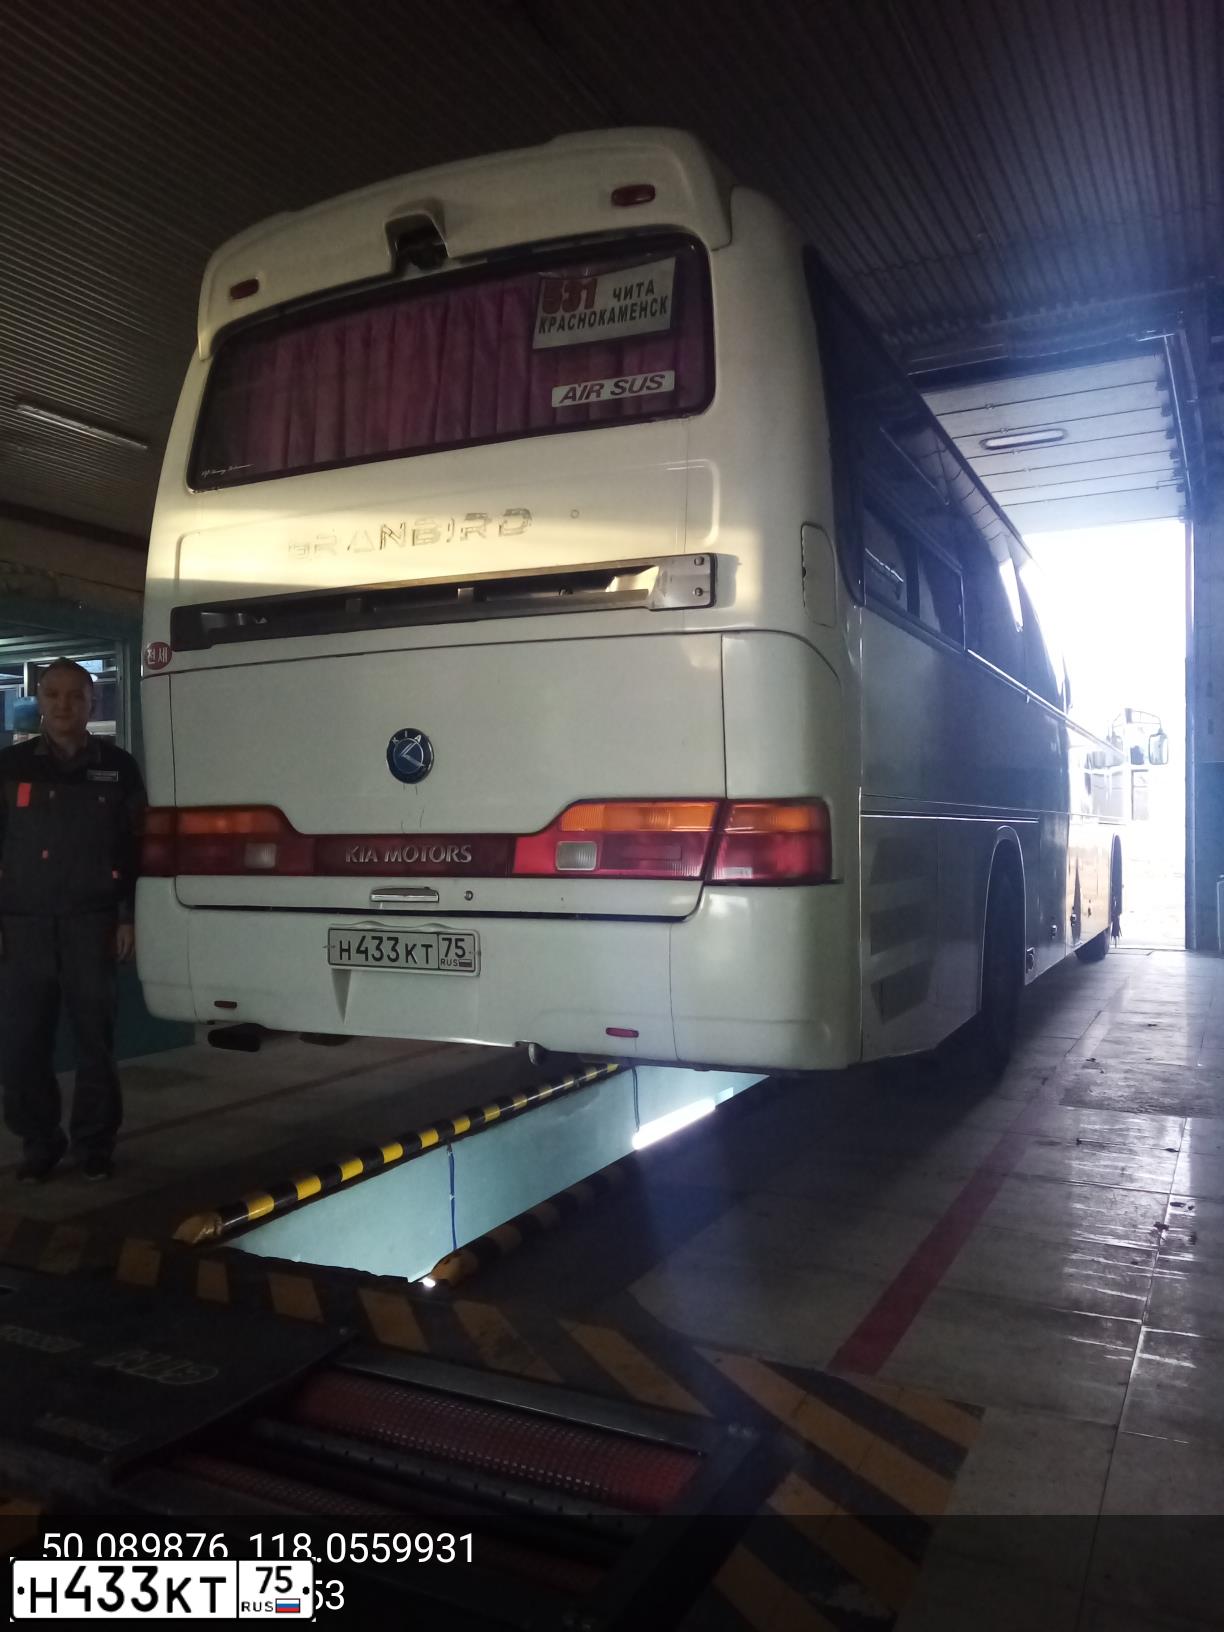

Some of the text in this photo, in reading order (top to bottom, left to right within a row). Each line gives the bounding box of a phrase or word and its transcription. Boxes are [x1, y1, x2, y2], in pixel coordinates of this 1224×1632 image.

[612, 279, 655, 302] ЧИТА
[538, 295, 669, 335] КРАСНОКАМЕНСК
[559, 374, 666, 404] AIR SUS
[345, 844, 472, 863] KIA MOTORS
[441, 937, 466, 959] 75
[440, 958, 459, 967] RUS
